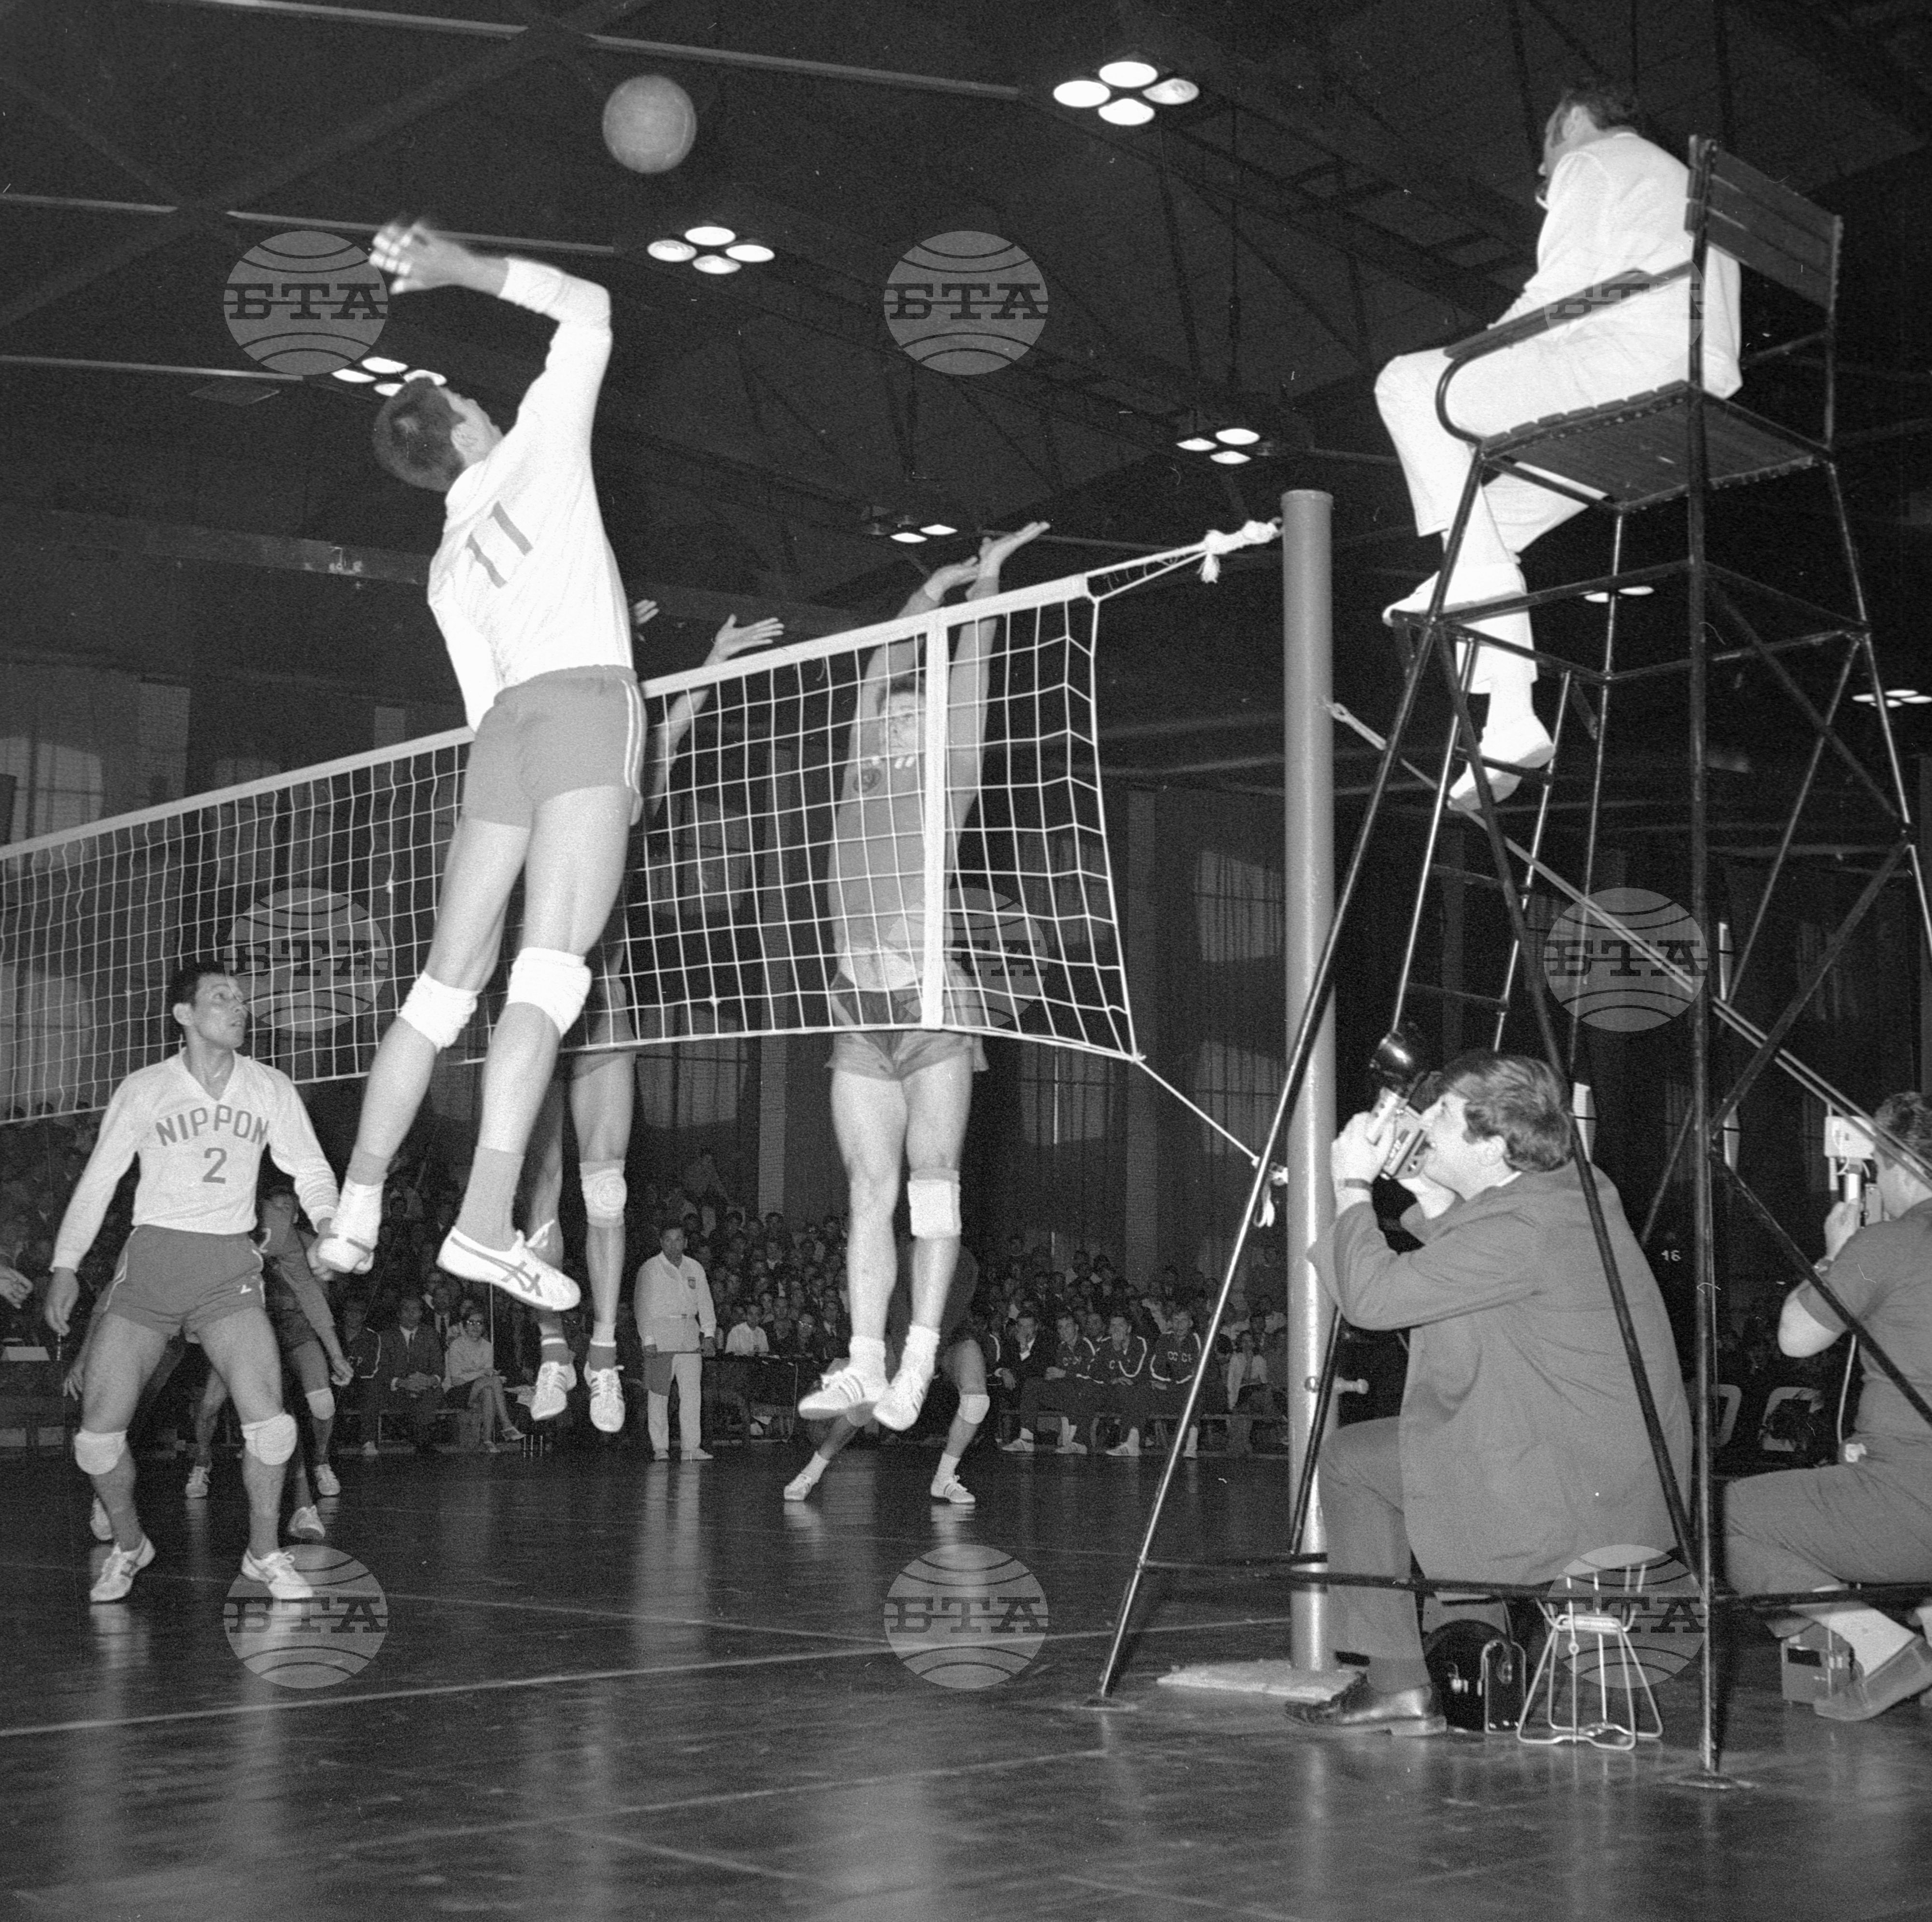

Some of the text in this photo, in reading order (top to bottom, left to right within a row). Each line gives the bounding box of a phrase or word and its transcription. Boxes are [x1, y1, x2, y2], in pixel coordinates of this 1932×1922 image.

[465, 500, 533, 589] 11
[155, 1104, 269, 1147] NIPPON
[202, 1147, 227, 1184] 2
